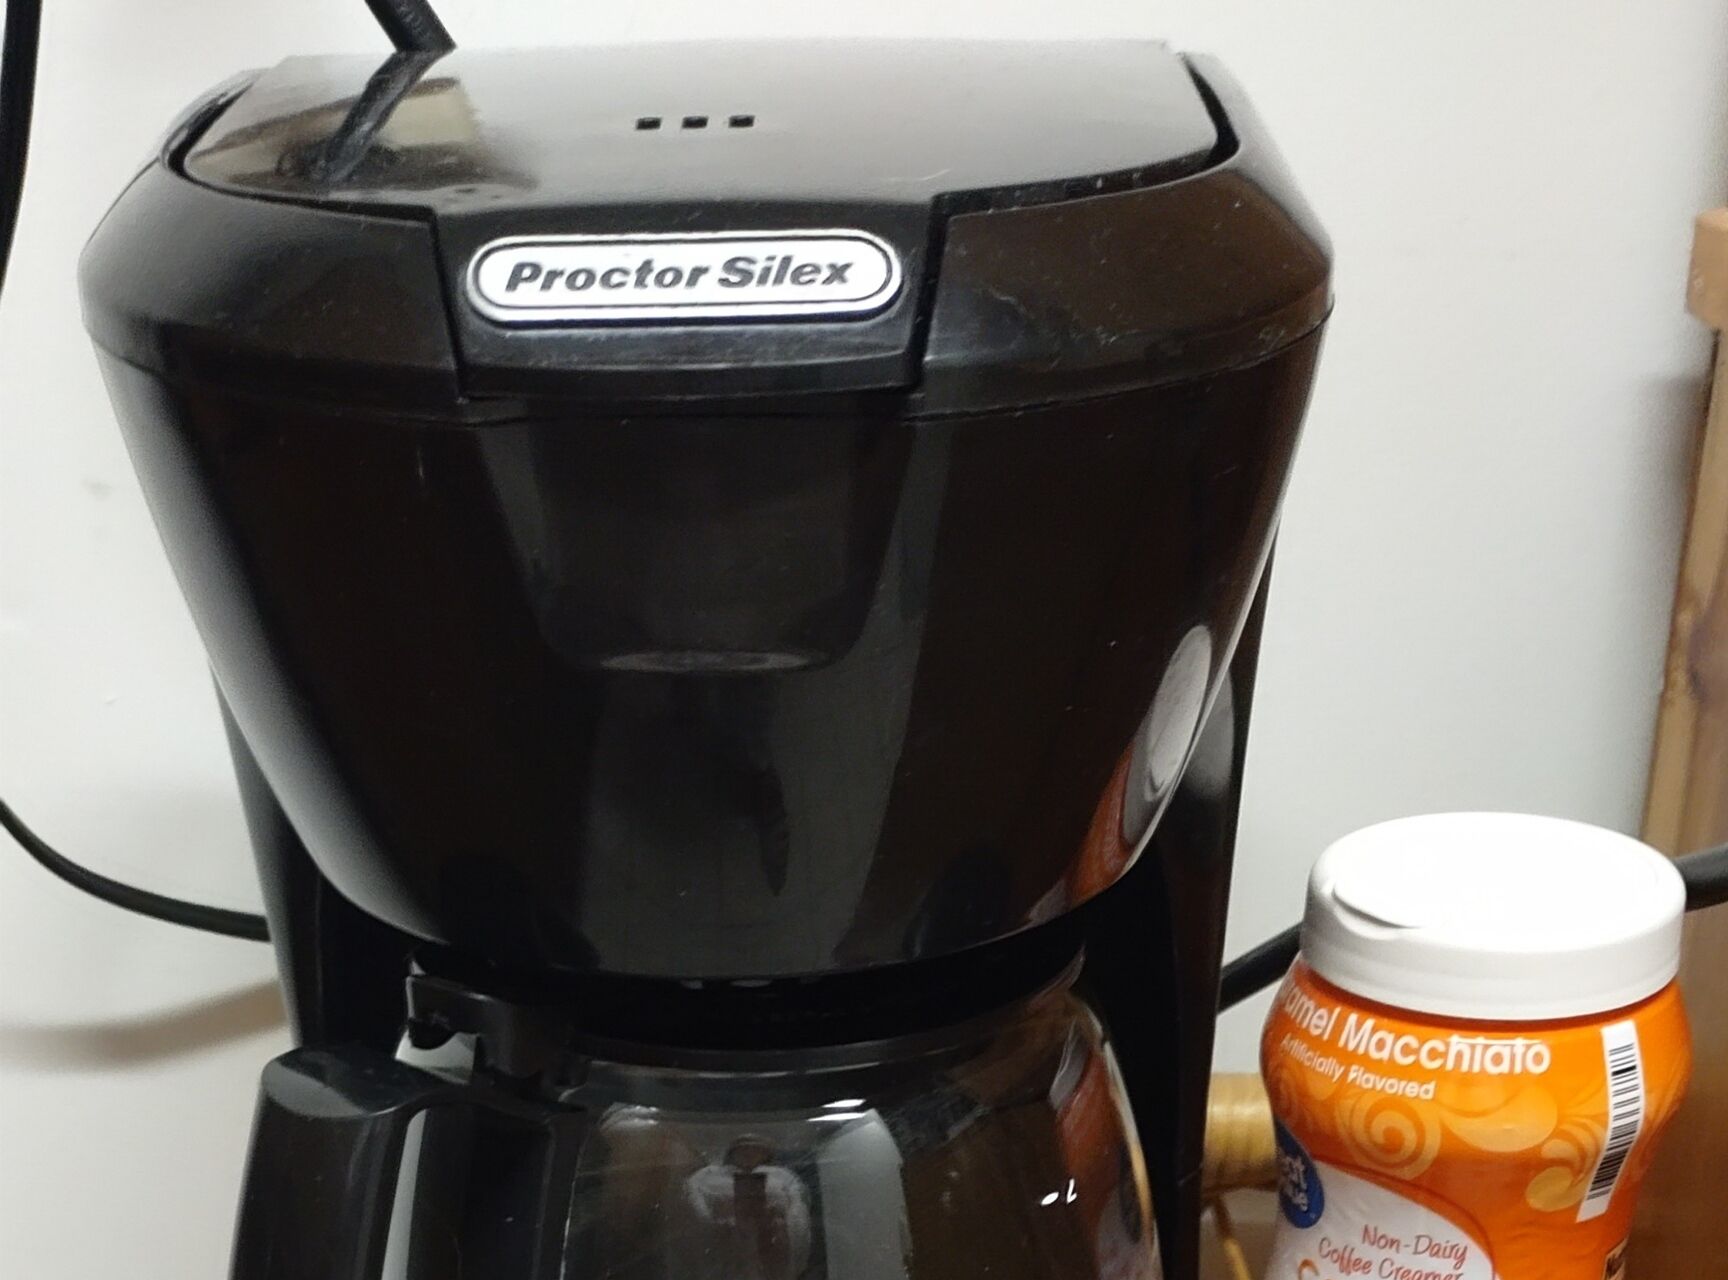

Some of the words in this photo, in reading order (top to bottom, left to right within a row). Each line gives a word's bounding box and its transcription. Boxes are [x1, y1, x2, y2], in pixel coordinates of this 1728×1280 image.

[505, 257, 710, 294] Proctor
[717, 254, 854, 289] Silex
[1283, 984, 1341, 1042] amel
[1338, 1013, 1552, 1076] Macchiato
[1280, 1033, 1346, 1083] Artificially
[1347, 1064, 1437, 1101] Flavored
[1318, 1236, 1374, 1276] Coffee
[1361, 1223, 1469, 1272] Non-Dairy
